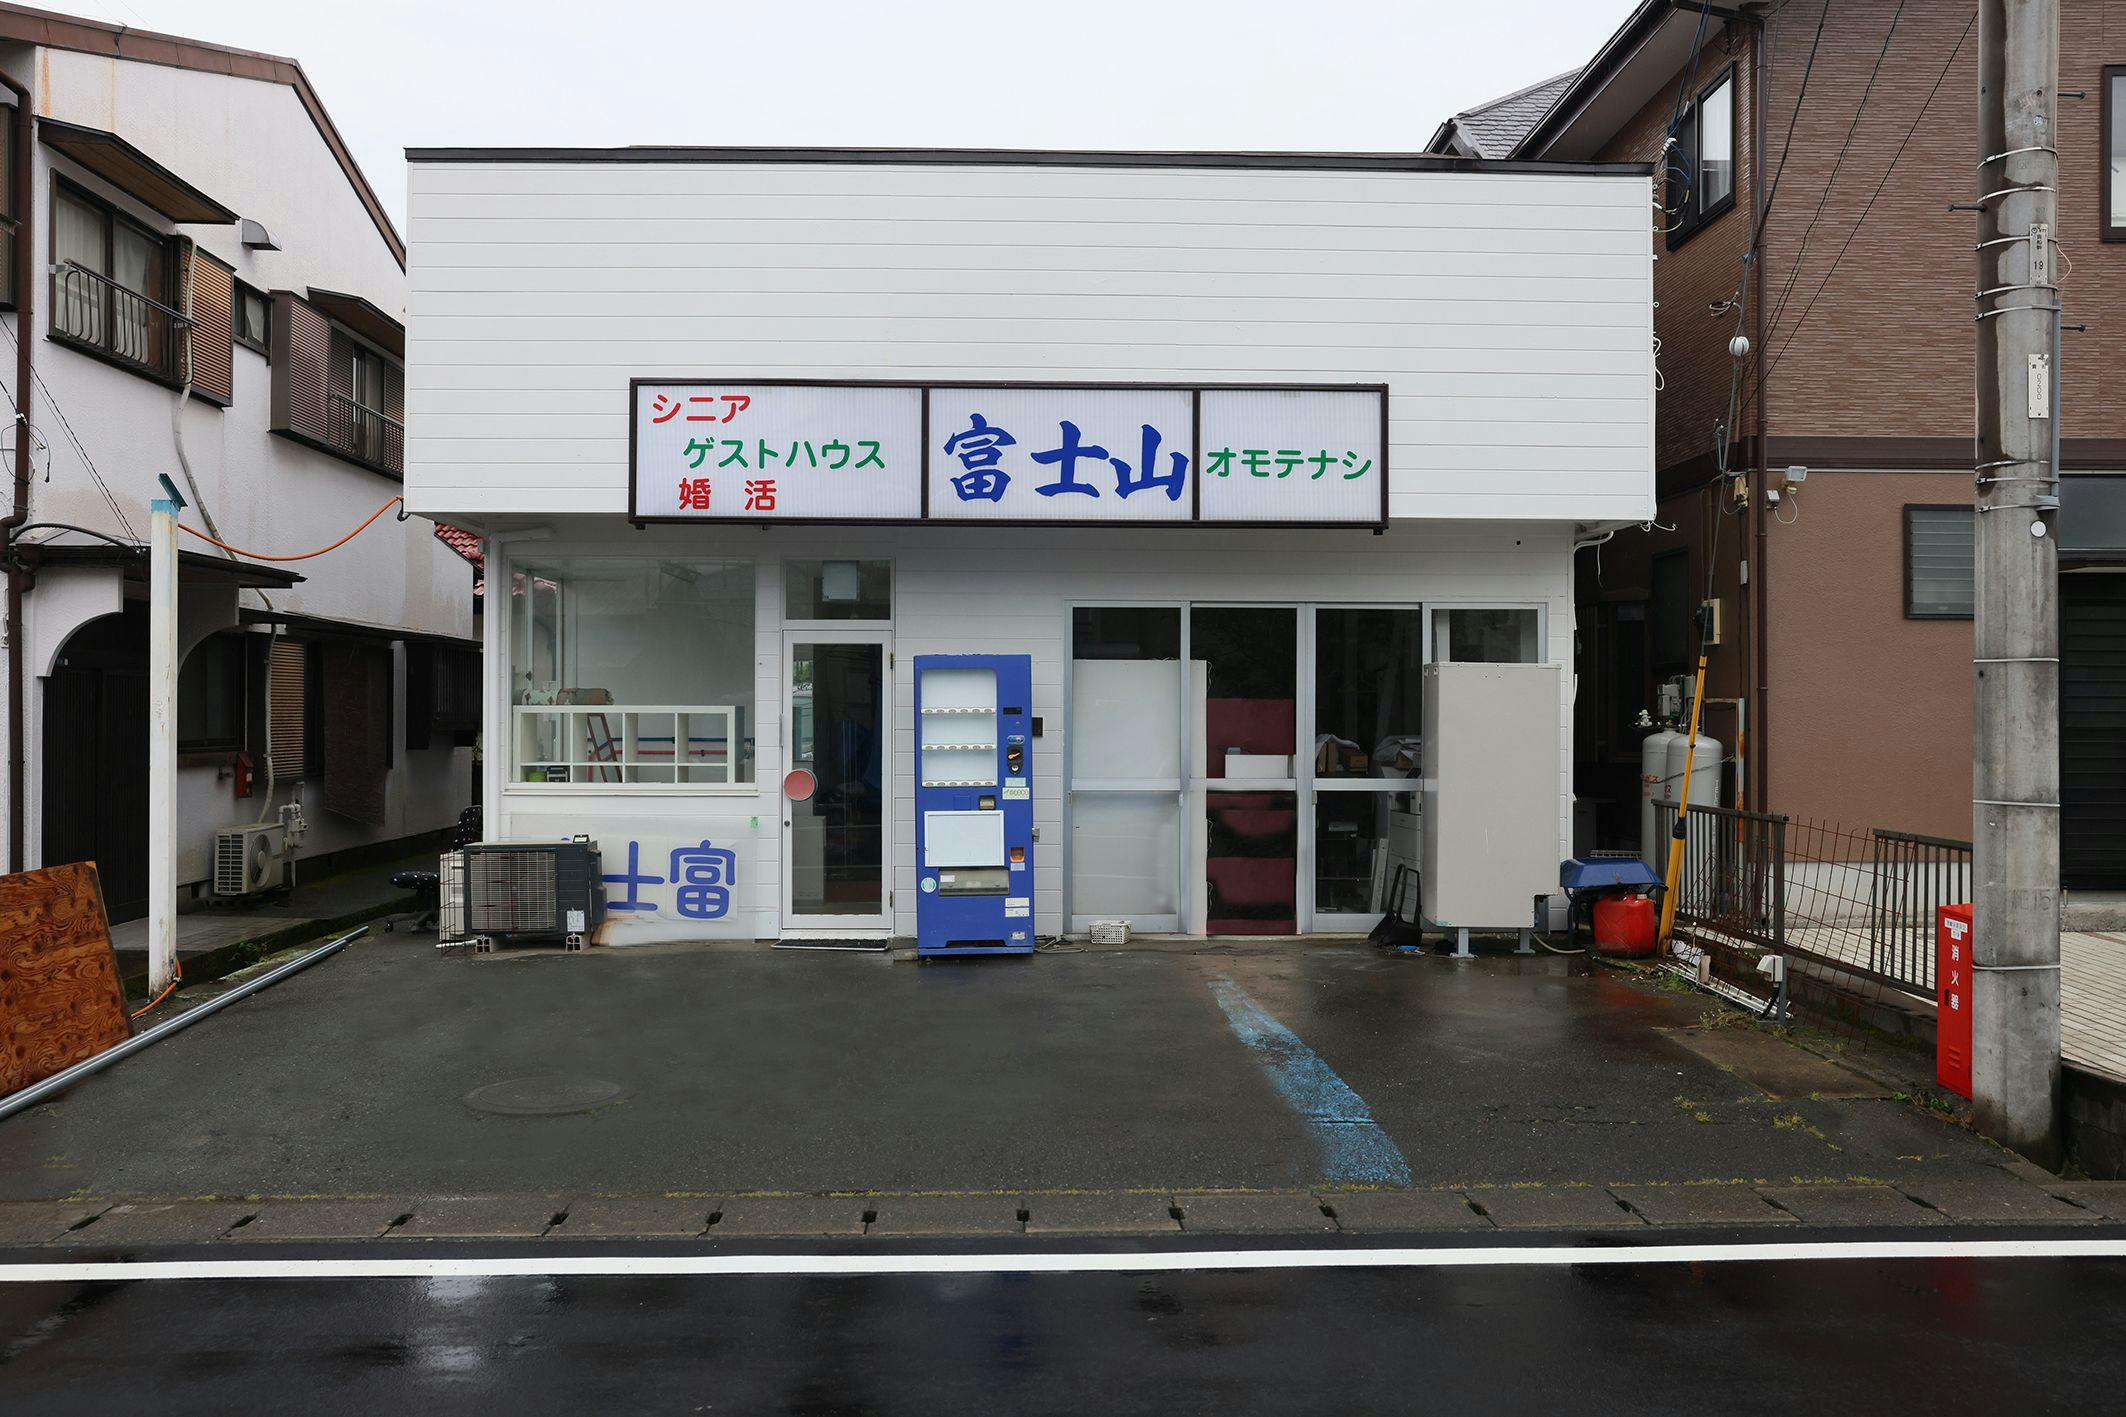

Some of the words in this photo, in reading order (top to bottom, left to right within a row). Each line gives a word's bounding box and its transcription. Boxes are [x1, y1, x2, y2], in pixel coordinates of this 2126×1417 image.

[652, 394, 751, 424] シニア
[683, 437, 886, 470] ゲストハウス
[943, 413, 1190, 503] 富士山
[1206, 447, 1372, 480] オモテナシ
